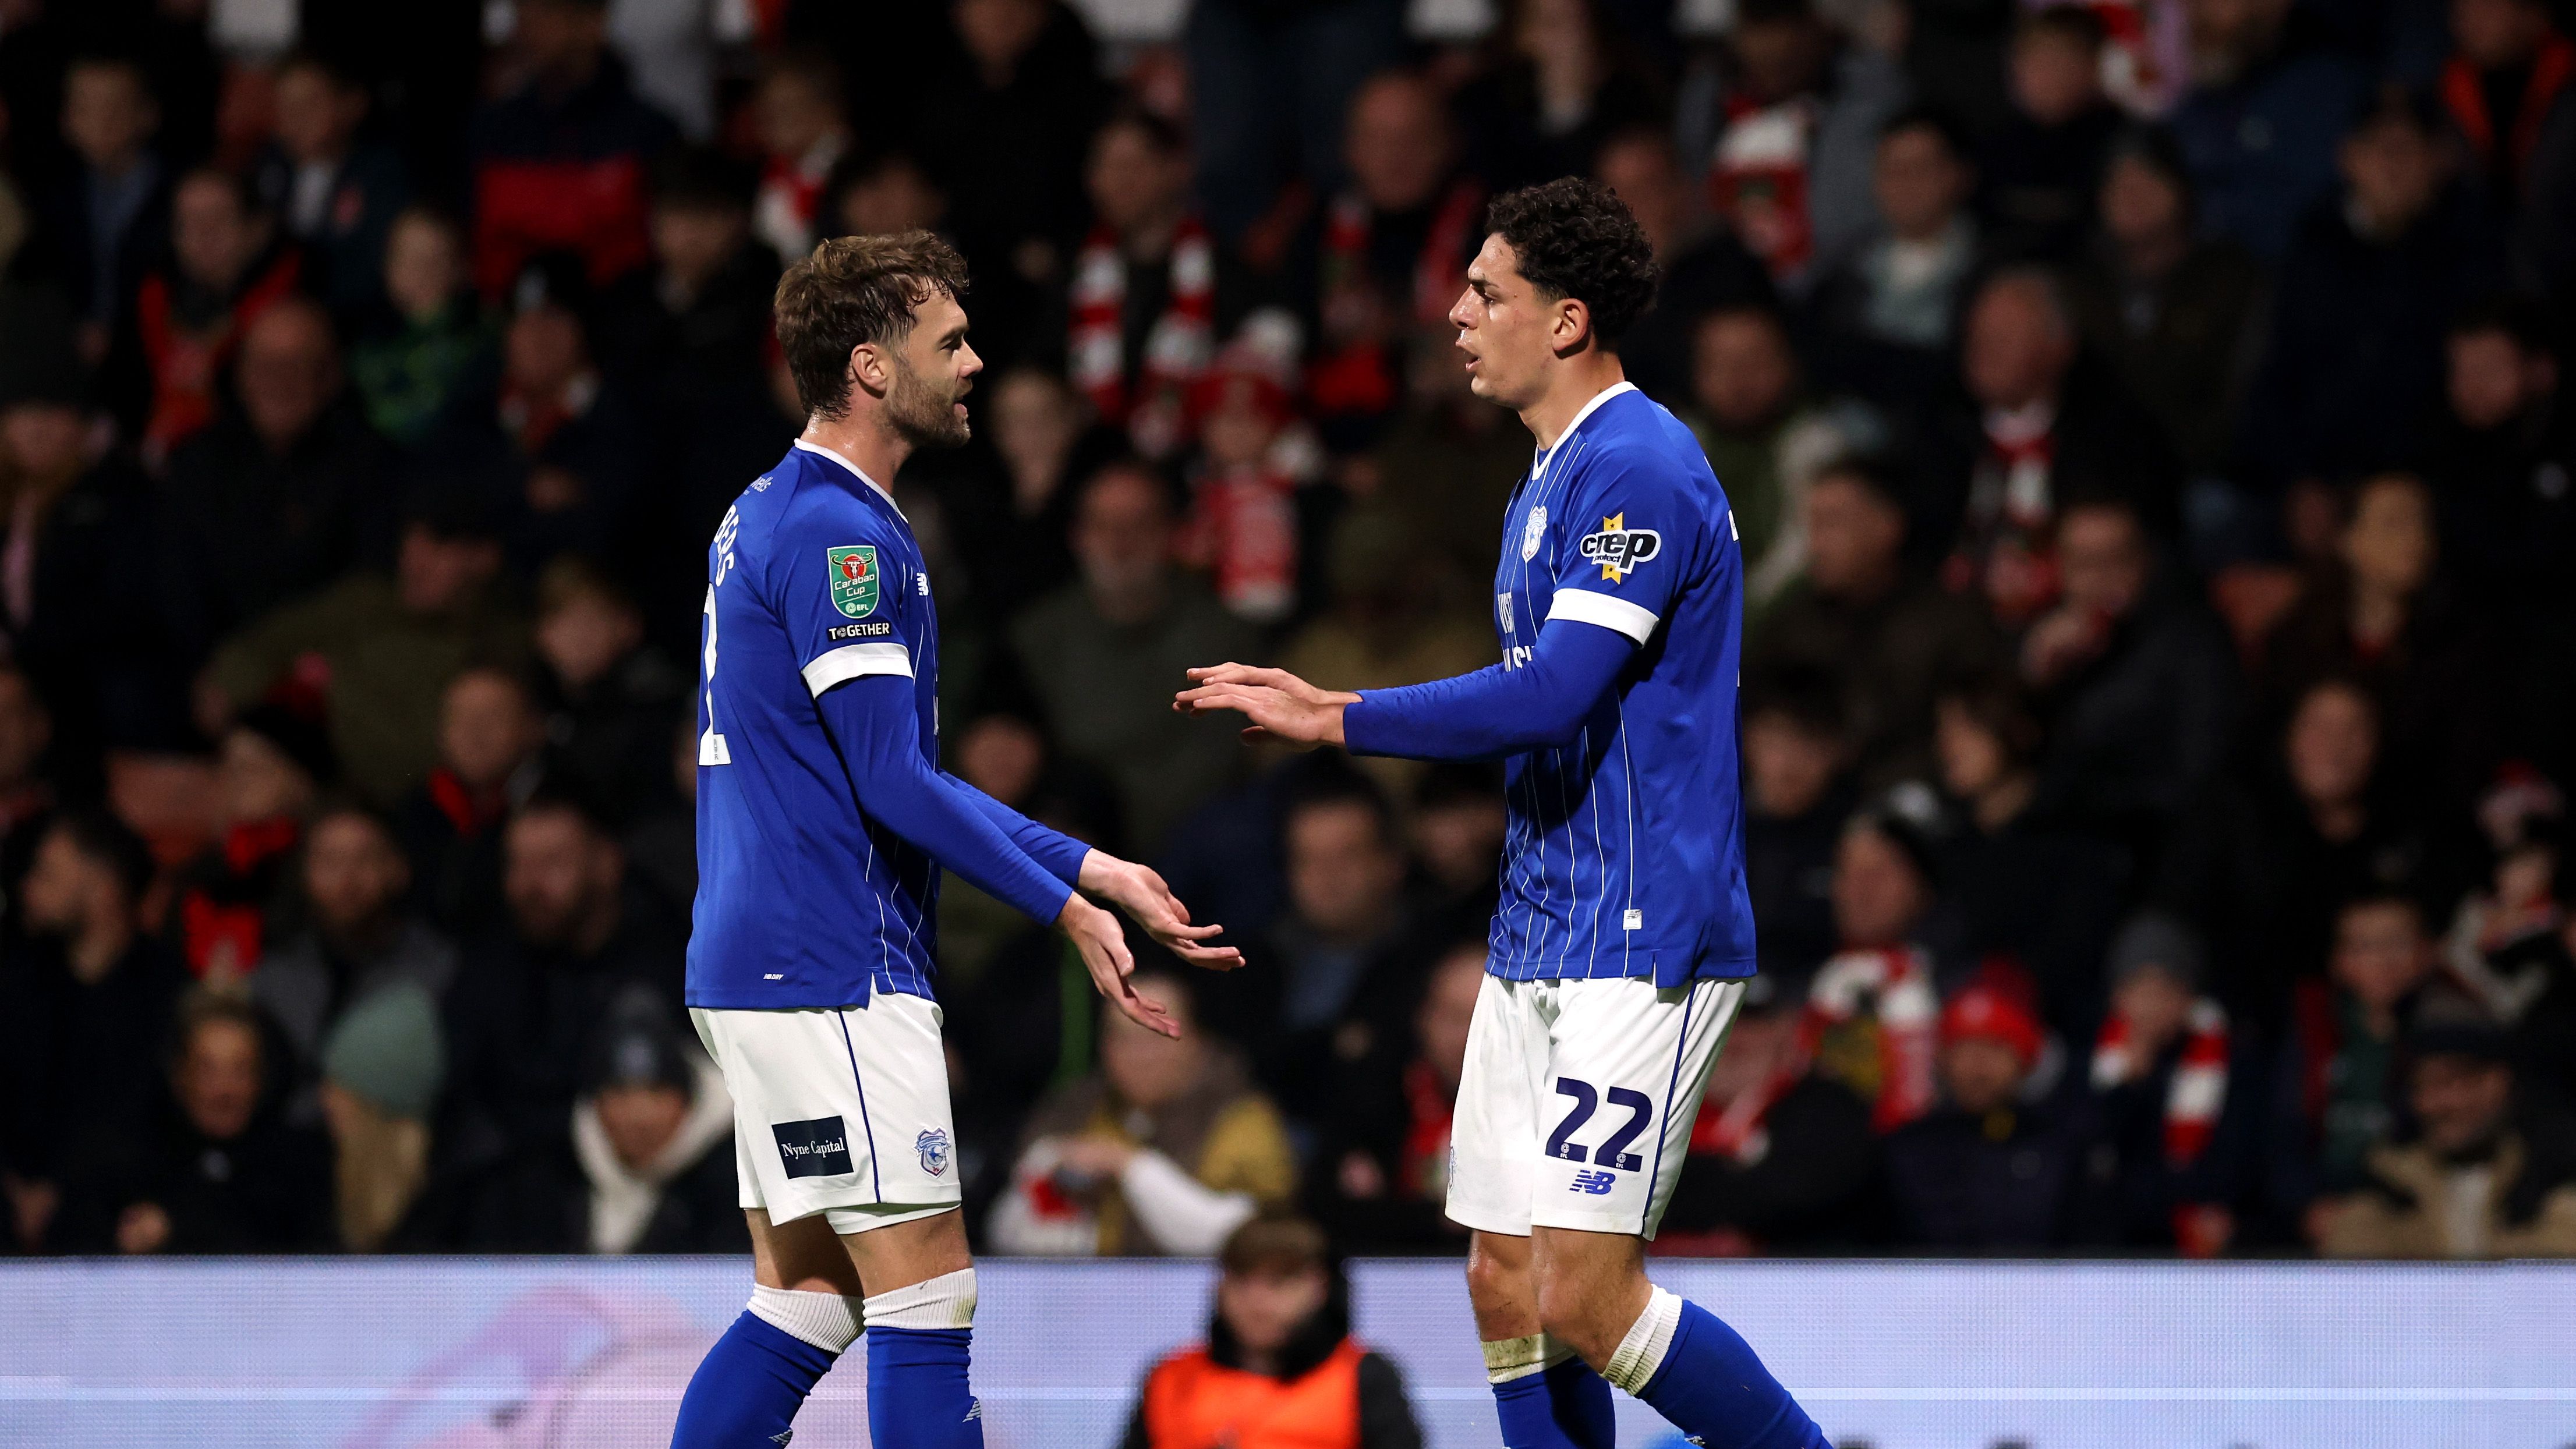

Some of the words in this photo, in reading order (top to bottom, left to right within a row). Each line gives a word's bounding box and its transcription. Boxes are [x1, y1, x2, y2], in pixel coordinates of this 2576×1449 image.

[1581, 533, 1657, 569] crep
[834, 574, 875, 590] Carabao
[847, 586, 865, 597] Cup
[1545, 1076, 1653, 1172] 22
[781, 1143, 810, 1160] Nyne
[811, 1137, 845, 1158] Capital
